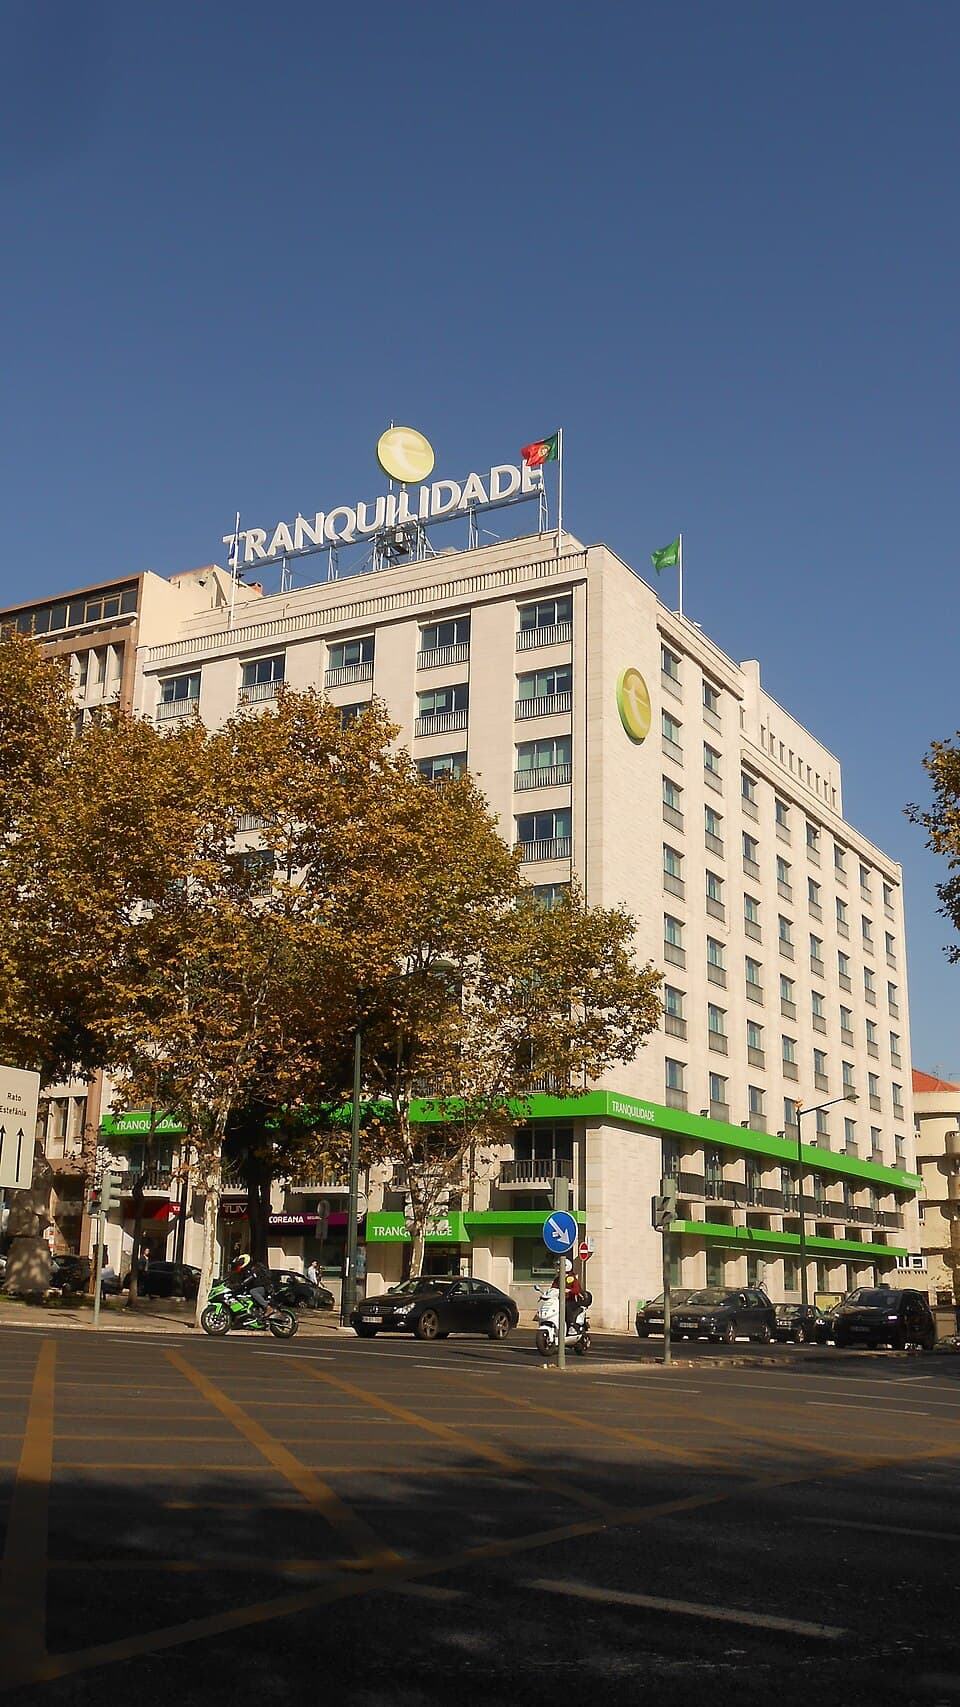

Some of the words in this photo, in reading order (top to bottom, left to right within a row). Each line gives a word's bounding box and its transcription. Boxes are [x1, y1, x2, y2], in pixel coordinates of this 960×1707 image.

[222, 459, 544, 566] TRANQUILIDADE
[7, 1092, 22, 1101] Rato
[611, 1100, 656, 1122] TRANQUILIDADE
[268, 1215, 304, 1224] COREANA
